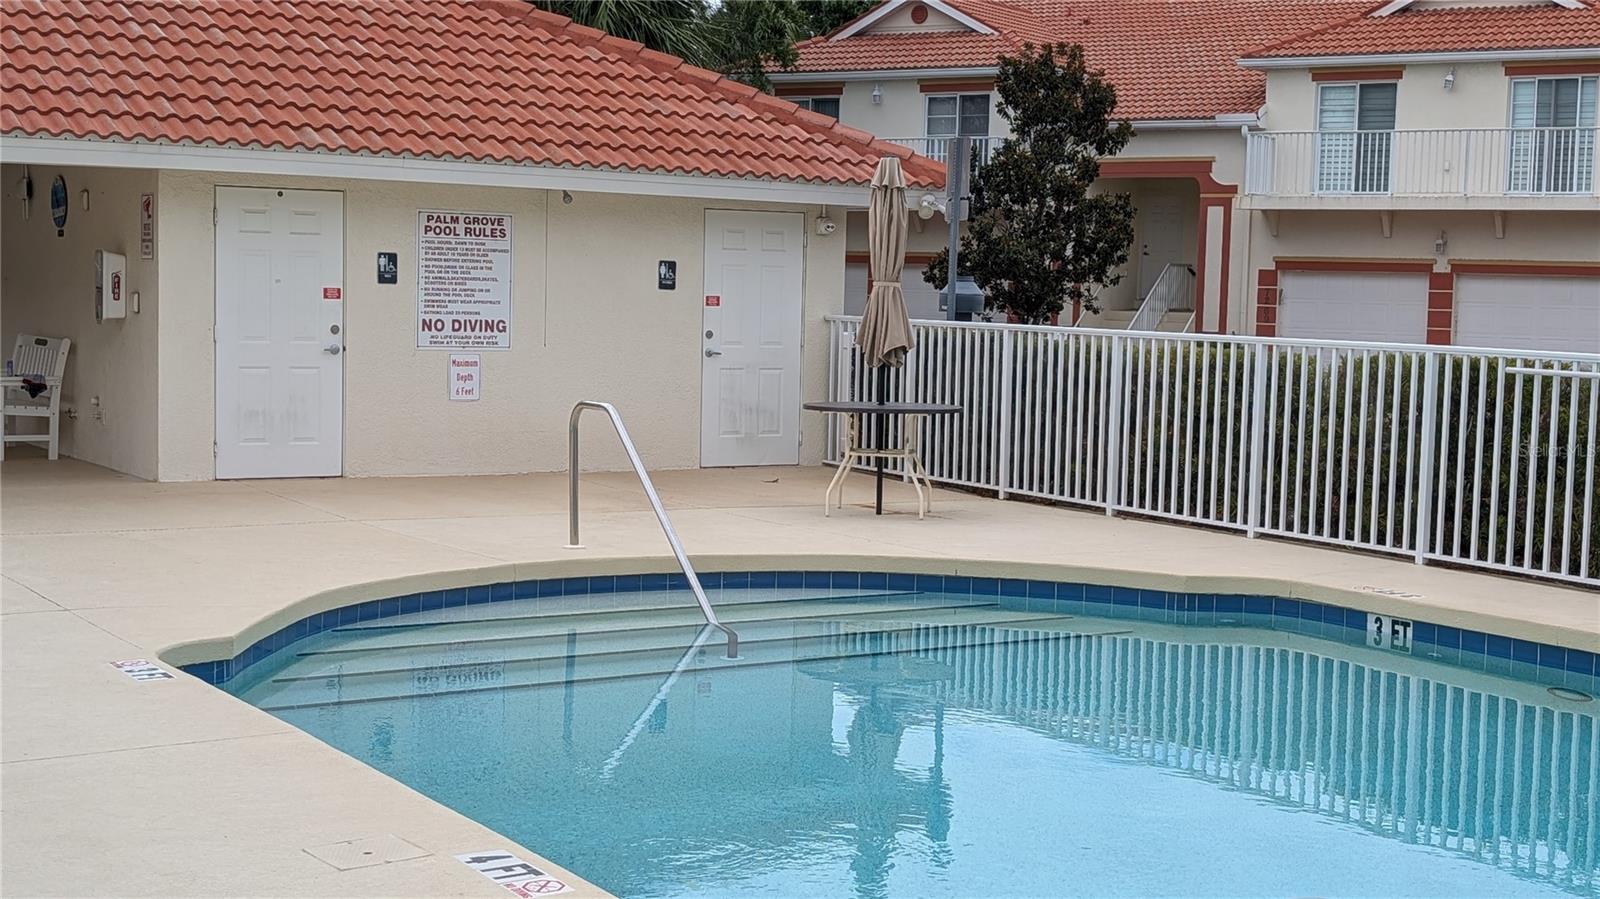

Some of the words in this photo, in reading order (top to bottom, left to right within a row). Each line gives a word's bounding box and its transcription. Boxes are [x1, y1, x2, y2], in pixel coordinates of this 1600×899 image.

[426, 214, 460, 224] PALM
[463, 216, 505, 226] GROVE
[424, 224, 460, 237] POOL
[464, 226, 507, 238] RULES
[422, 318, 445, 332] NO
[451, 318, 507, 333] DIVING
[452, 359, 479, 368] Maximum
[456, 373, 474, 384] Depth
[461, 387, 474, 396] Feet
[1373, 616, 1383, 646] 3
[464, 855, 514, 864] 4
[480, 863, 546, 880] FT
